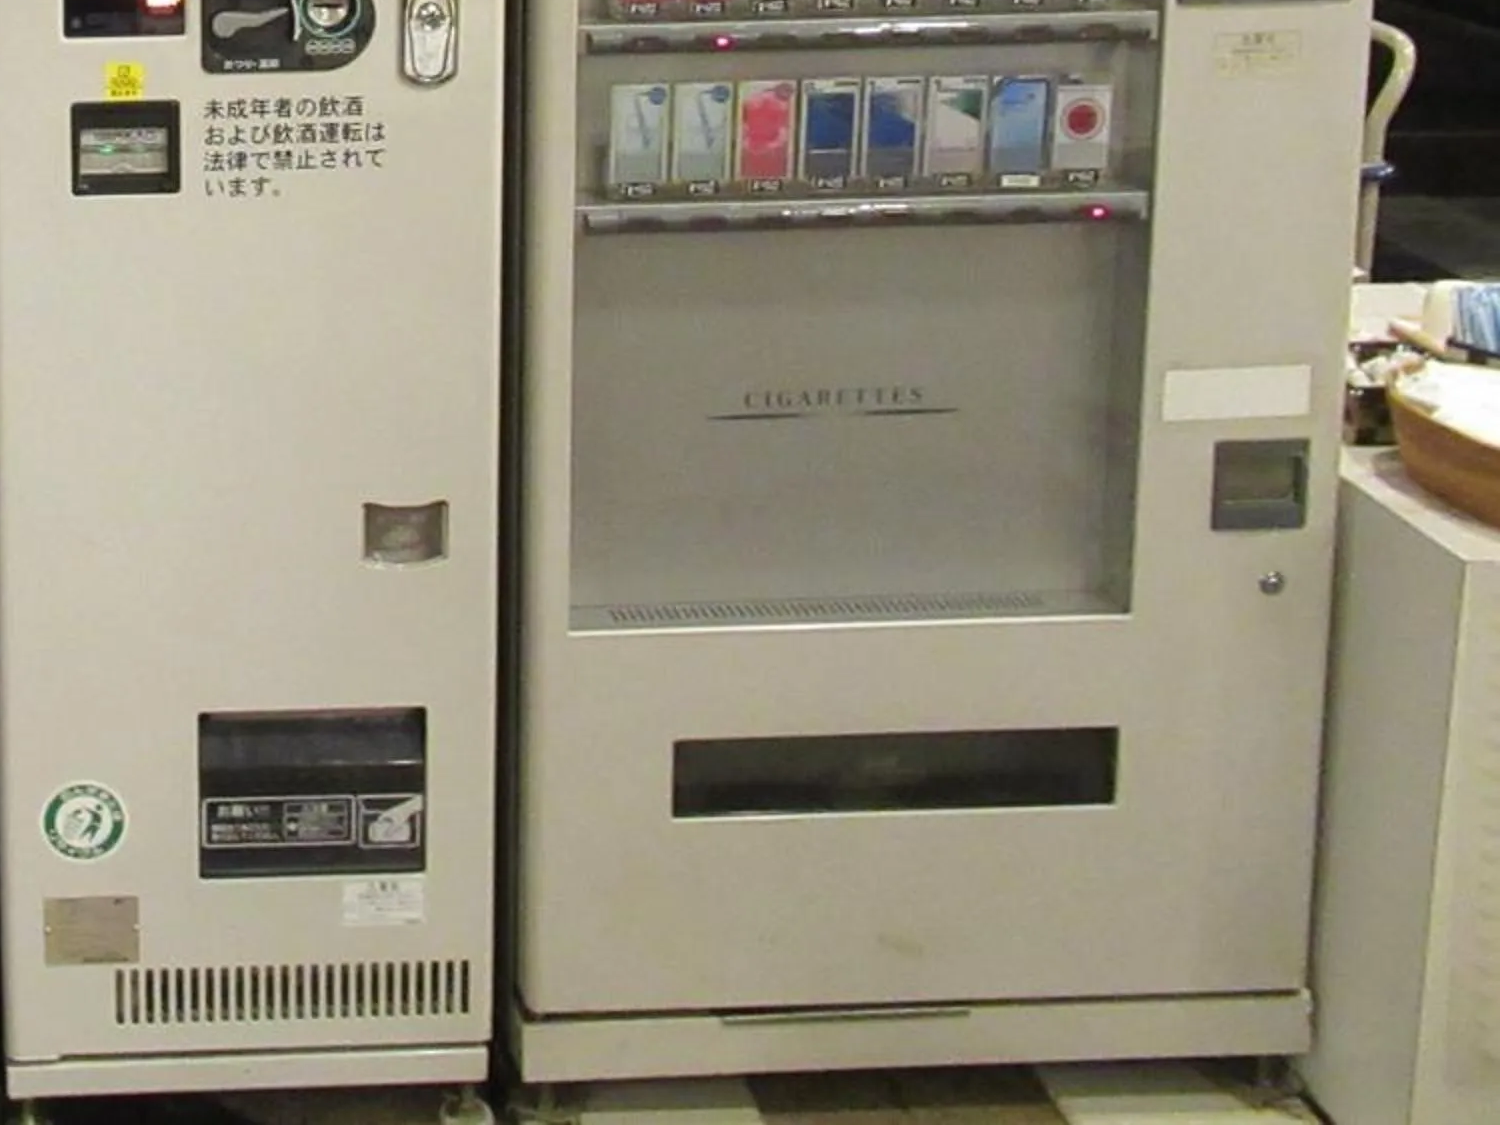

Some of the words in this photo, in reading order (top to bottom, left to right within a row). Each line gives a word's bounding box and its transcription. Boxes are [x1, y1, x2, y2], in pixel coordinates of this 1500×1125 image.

[203, 96, 365, 119] 未成年者の飲酒
[203, 121, 387, 146] および飲酒運転は
[202, 148, 385, 172] 法律で禁止されて
[204, 176, 282, 198] います。
[743, 385, 925, 409] CIGARETTES
